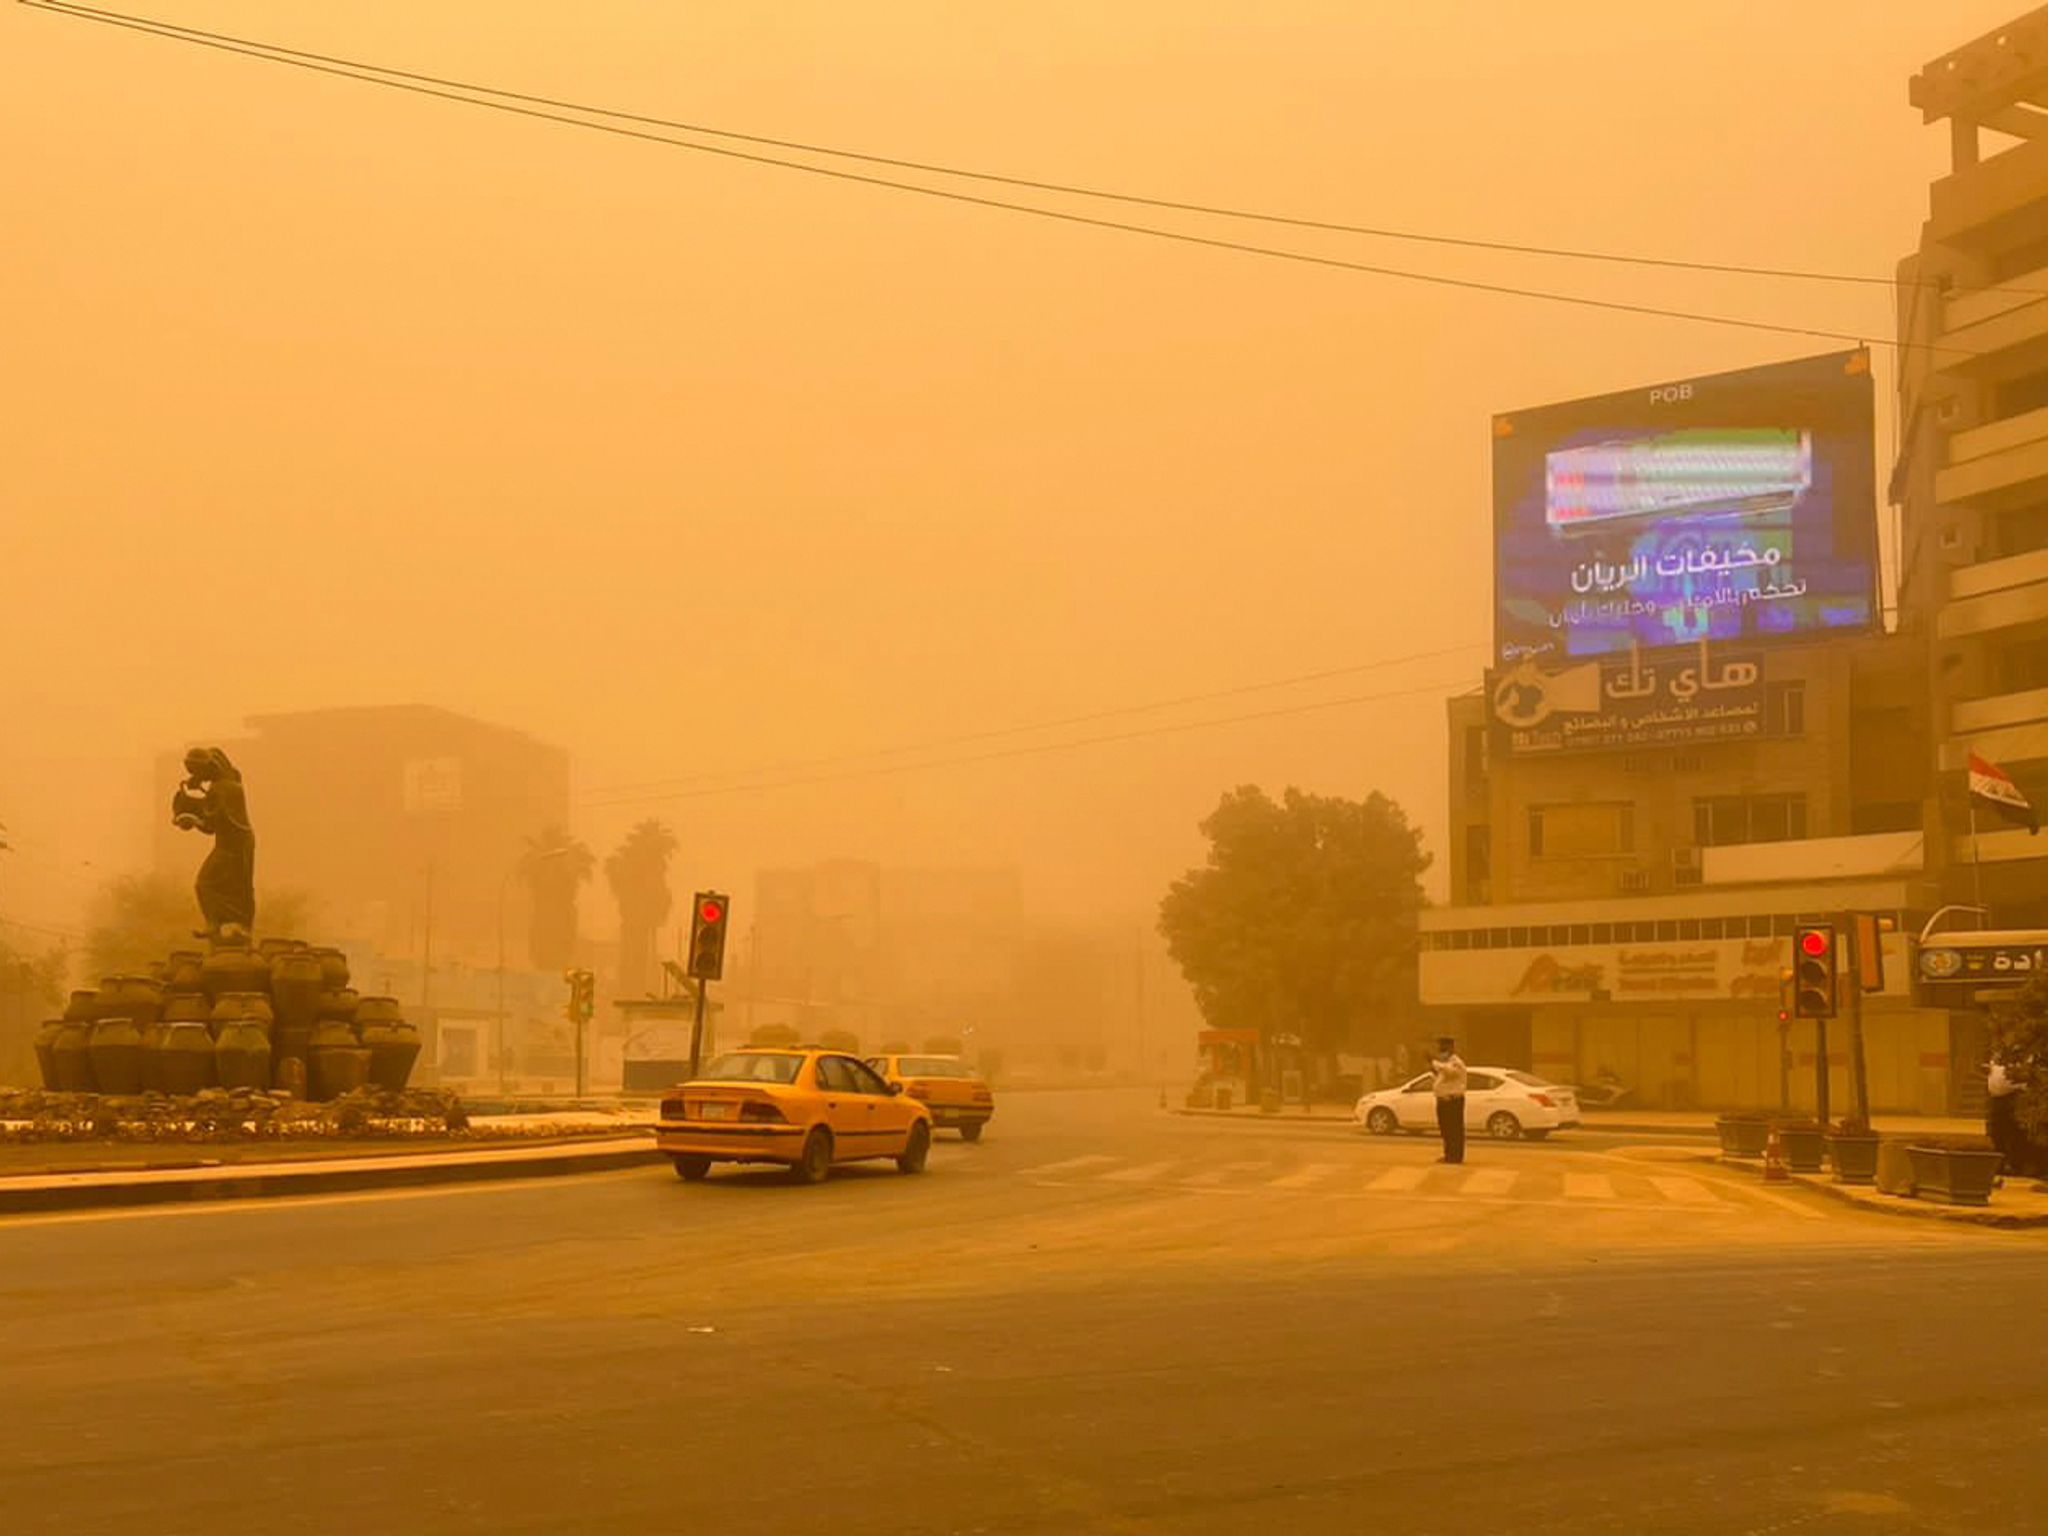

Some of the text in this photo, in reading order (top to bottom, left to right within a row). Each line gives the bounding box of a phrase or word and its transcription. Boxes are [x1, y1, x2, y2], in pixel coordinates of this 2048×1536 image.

[1570, 553, 1648, 592] الريان
[1606, 636, 1757, 703] هاي تك
